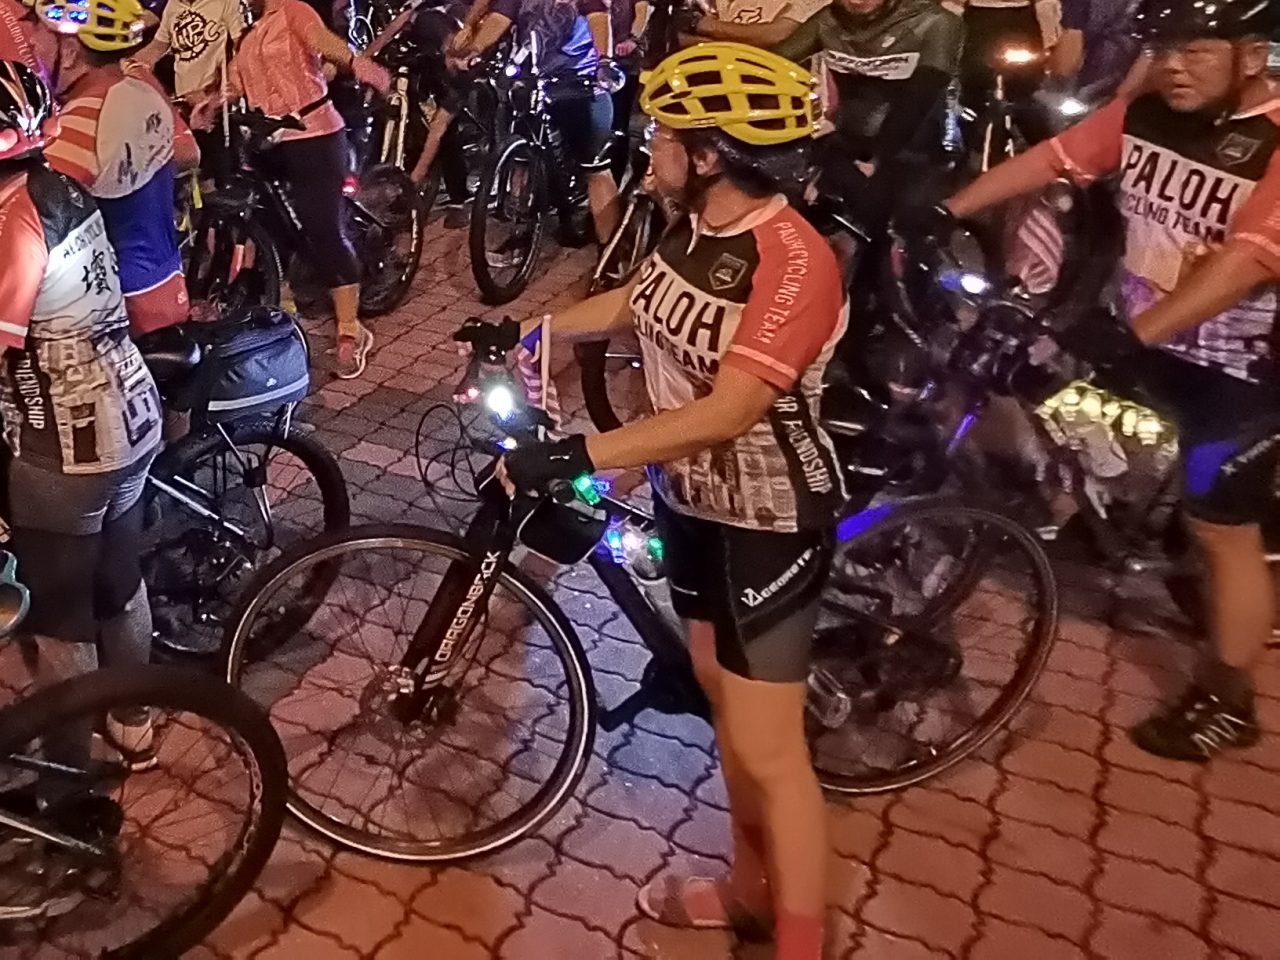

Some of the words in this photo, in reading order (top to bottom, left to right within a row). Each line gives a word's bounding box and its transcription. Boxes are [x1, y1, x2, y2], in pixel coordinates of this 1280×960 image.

[1120, 144, 1240, 227] PALOH
[774, 249, 809, 306] CYCLING
[752, 306, 791, 344] TEAM
[14, 352, 45, 430] RIENDSHIP
